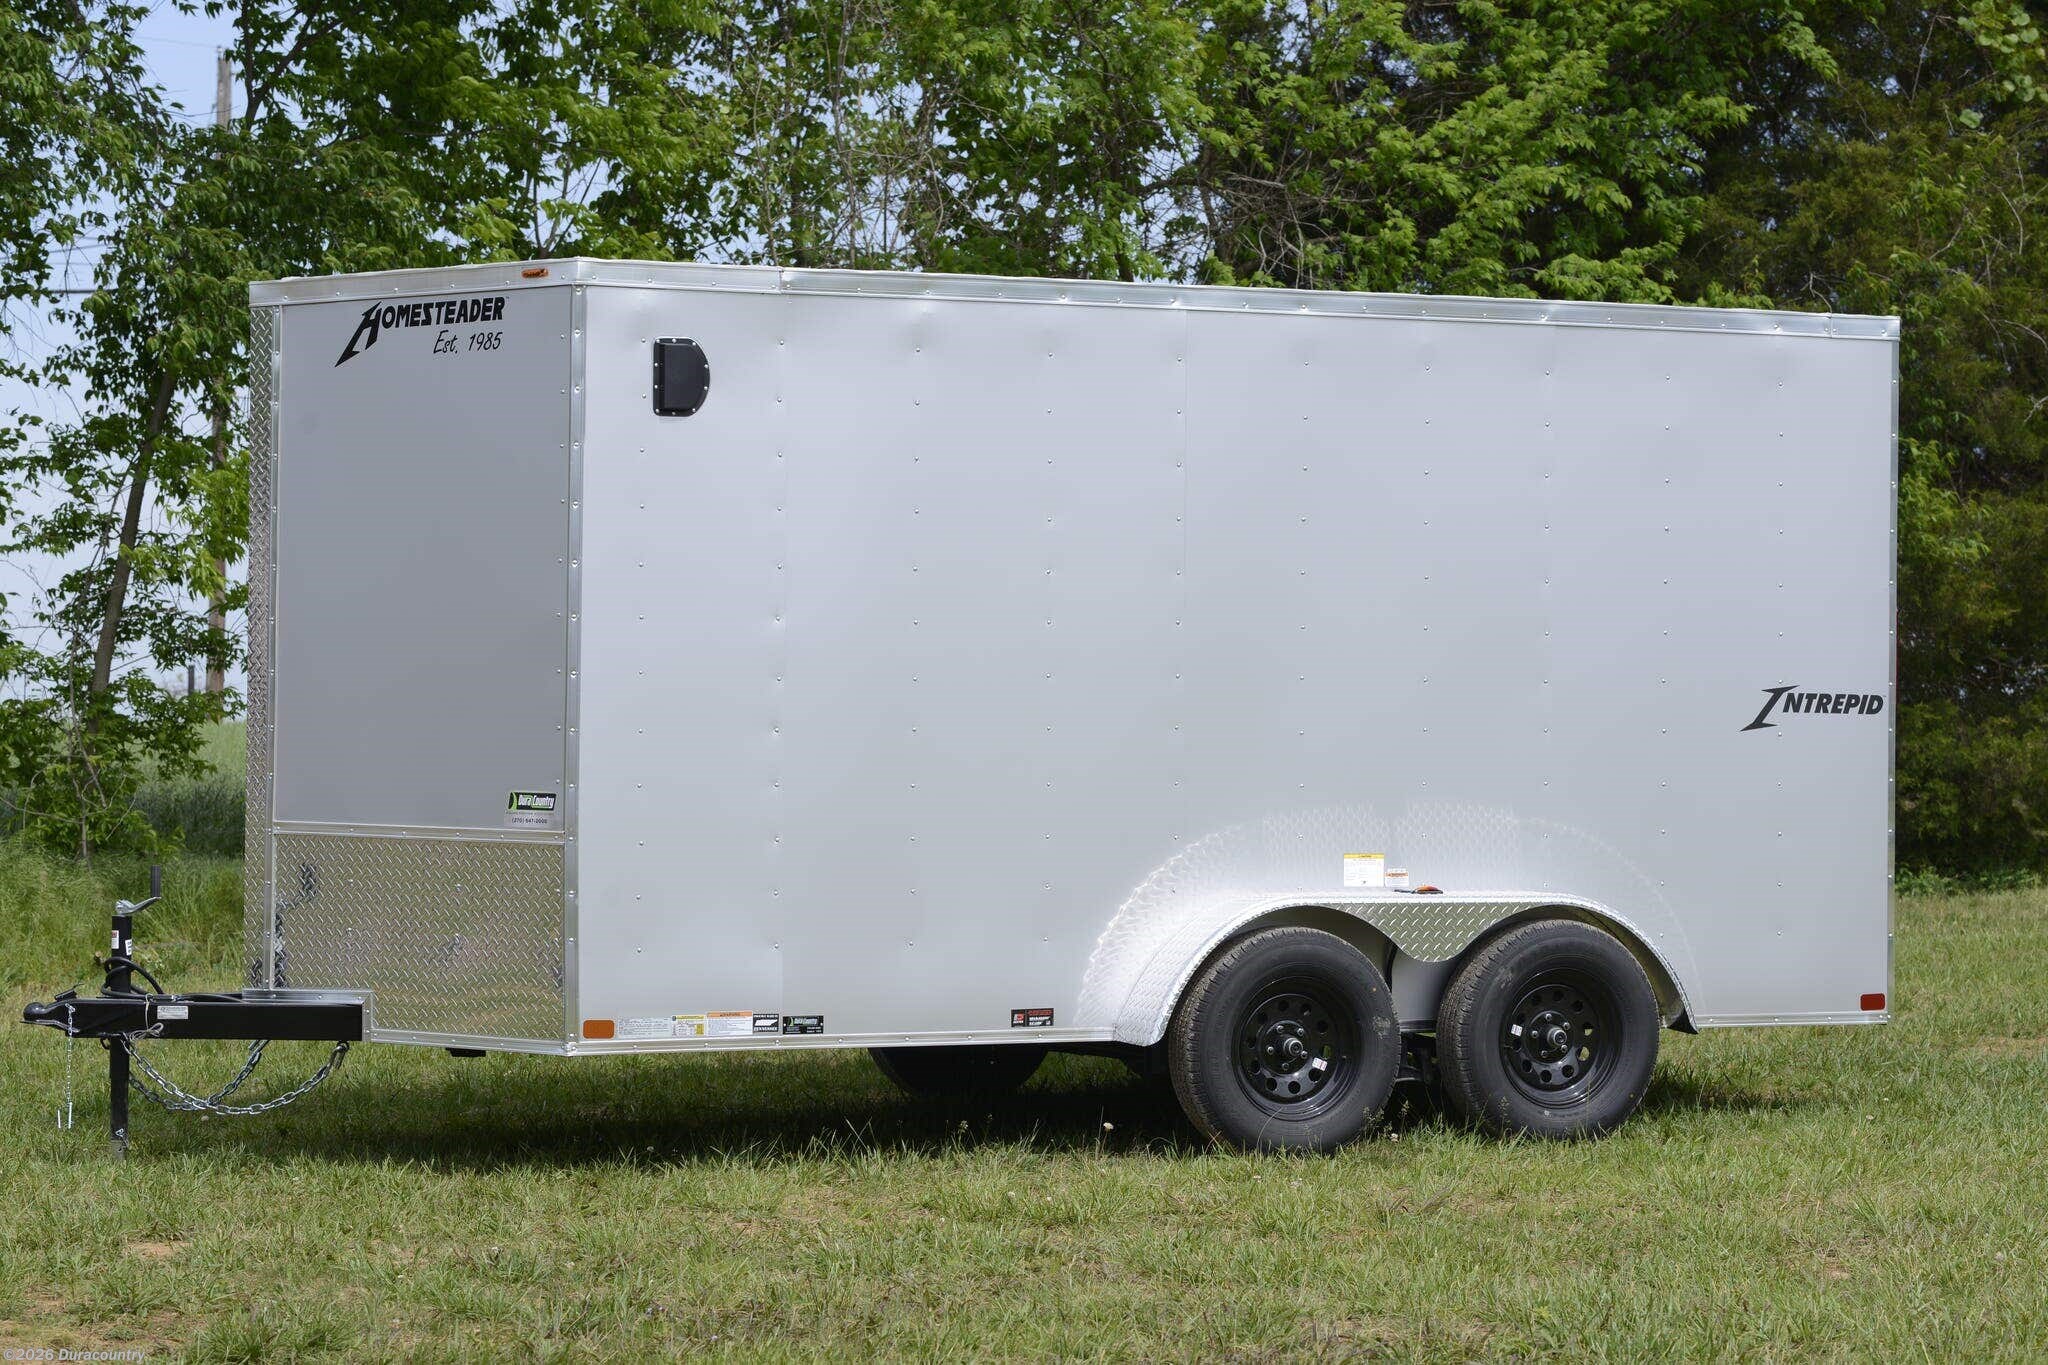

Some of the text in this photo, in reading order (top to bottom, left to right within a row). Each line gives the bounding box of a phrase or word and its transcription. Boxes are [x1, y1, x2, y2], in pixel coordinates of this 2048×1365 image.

[334, 296, 505, 368] HOMESTEADER
[433, 329, 503, 354] Est. 1985
[1740, 684, 1884, 732] INTREPID
[532, 795, 555, 809] Country
